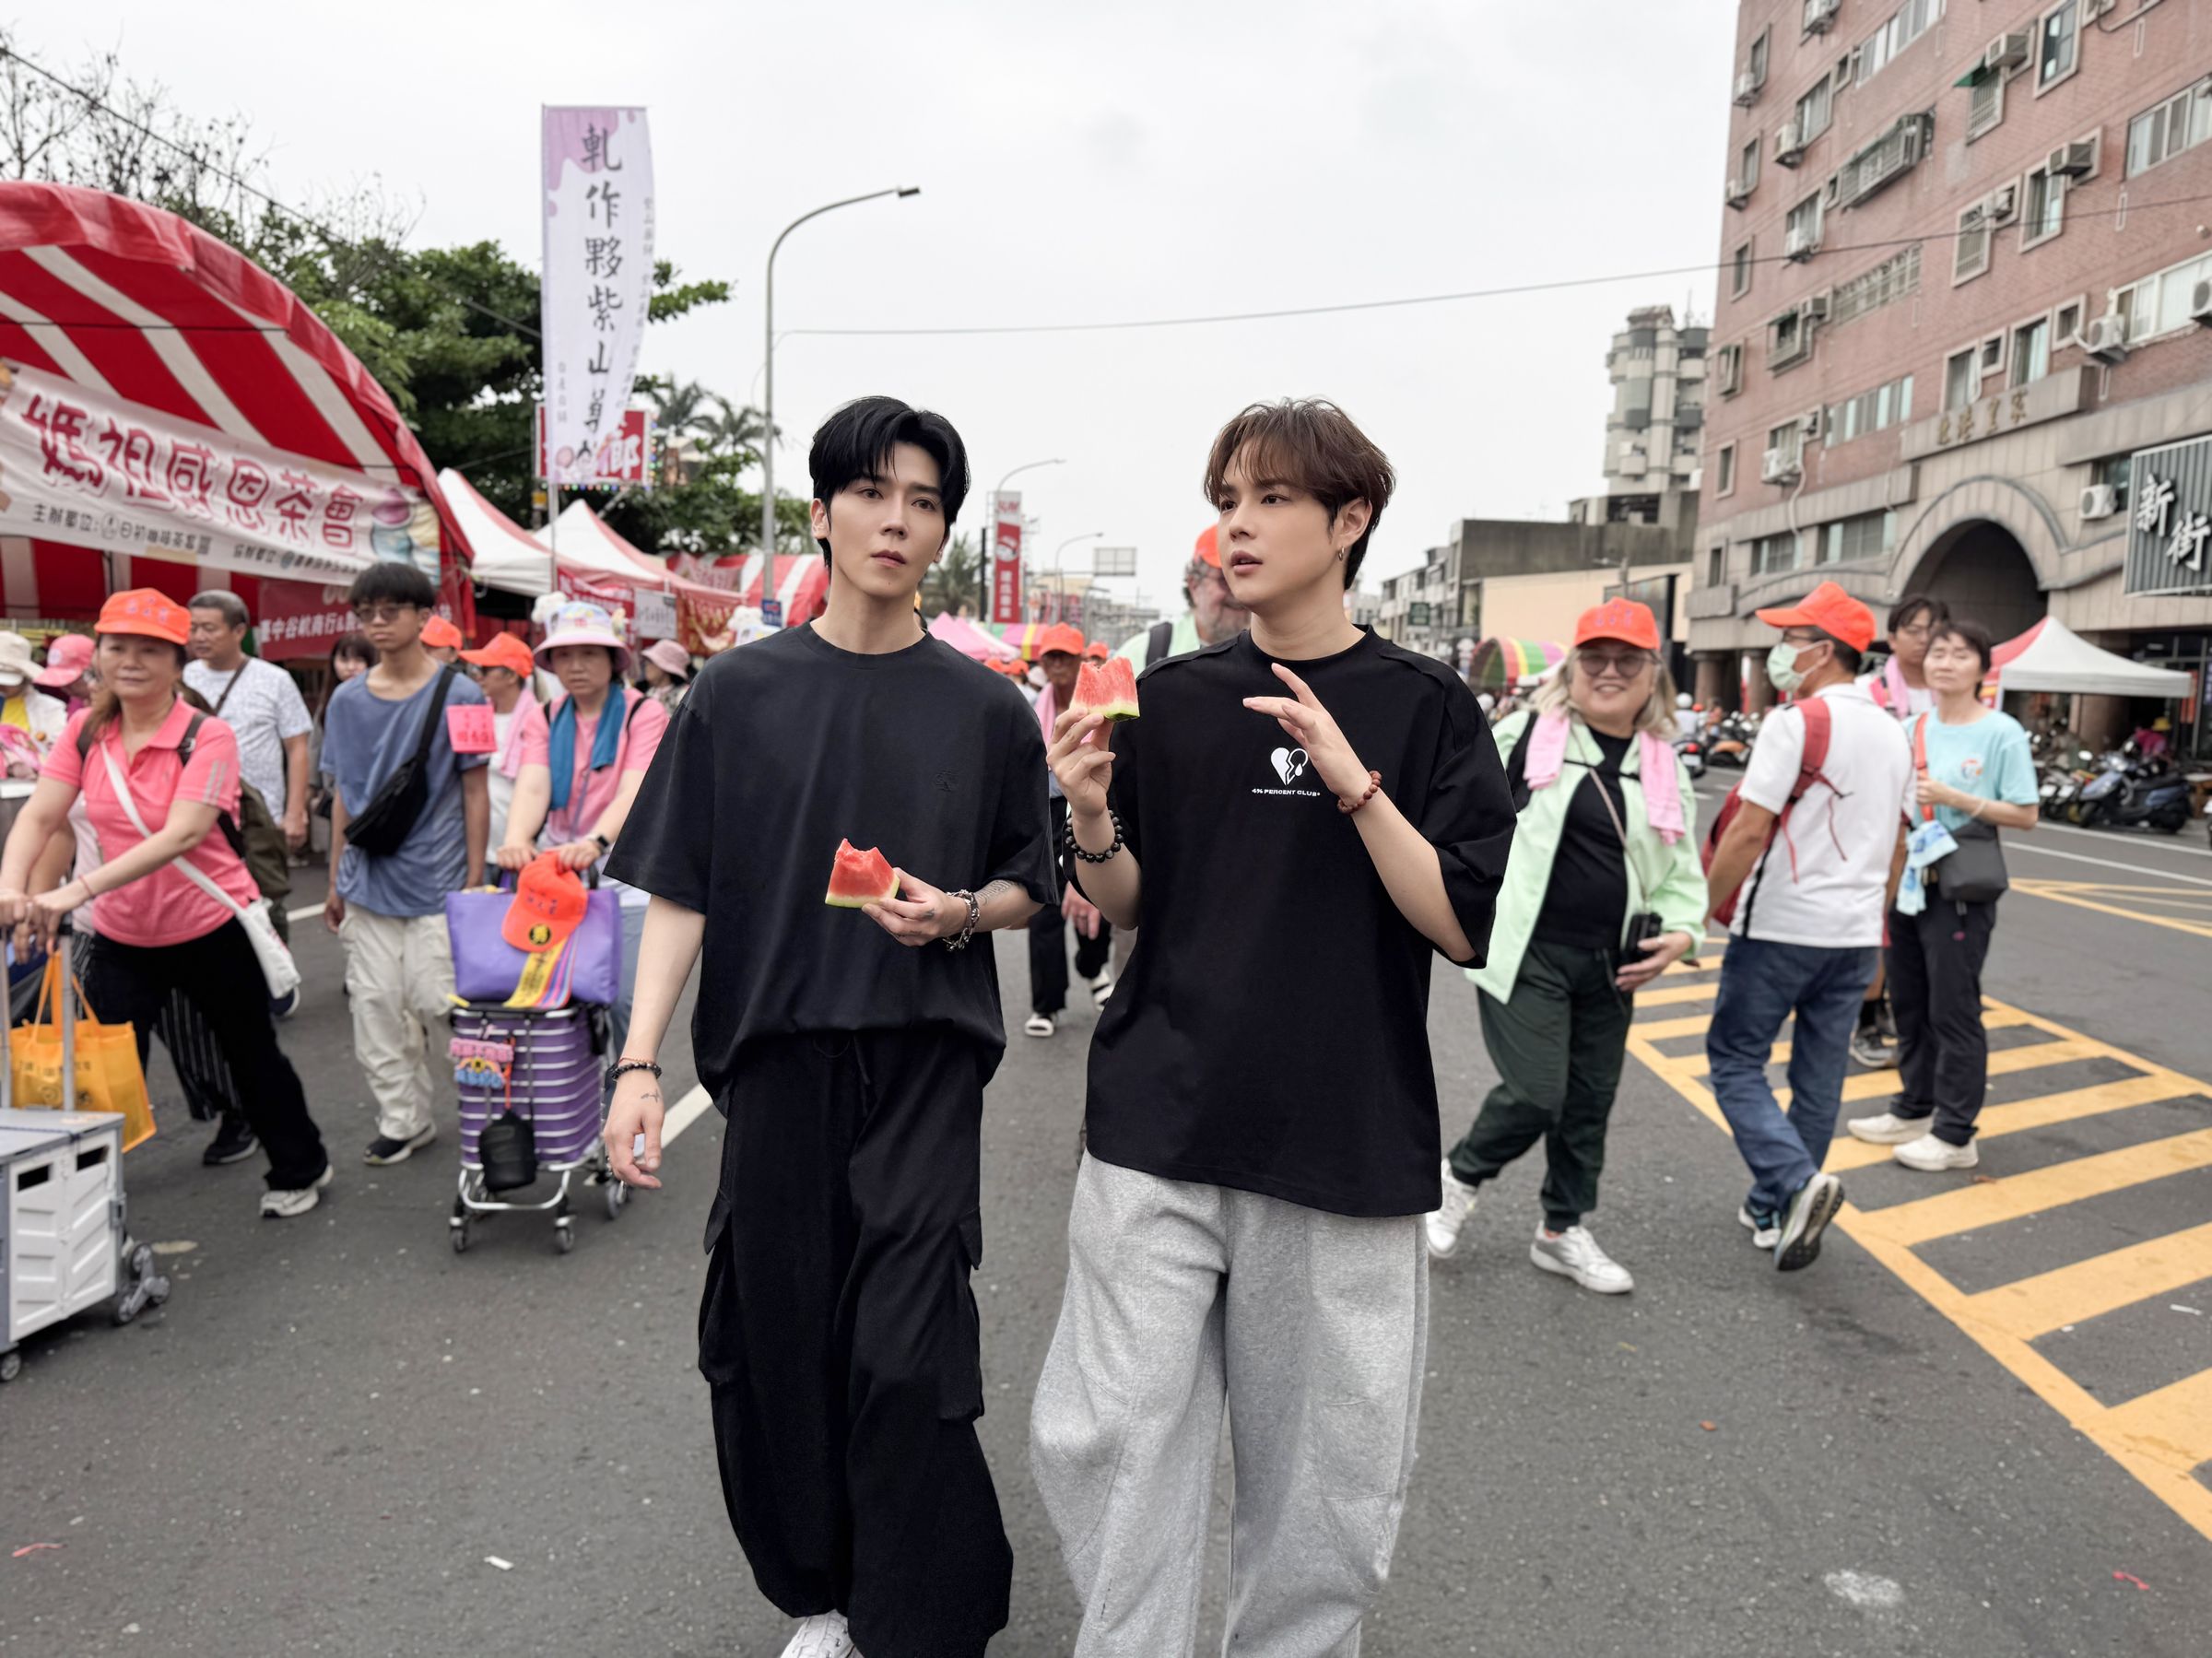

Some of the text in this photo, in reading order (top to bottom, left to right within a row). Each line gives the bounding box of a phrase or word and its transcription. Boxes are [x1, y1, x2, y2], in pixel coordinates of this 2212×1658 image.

[21, 394, 364, 550] 媽祖感恩茶會
